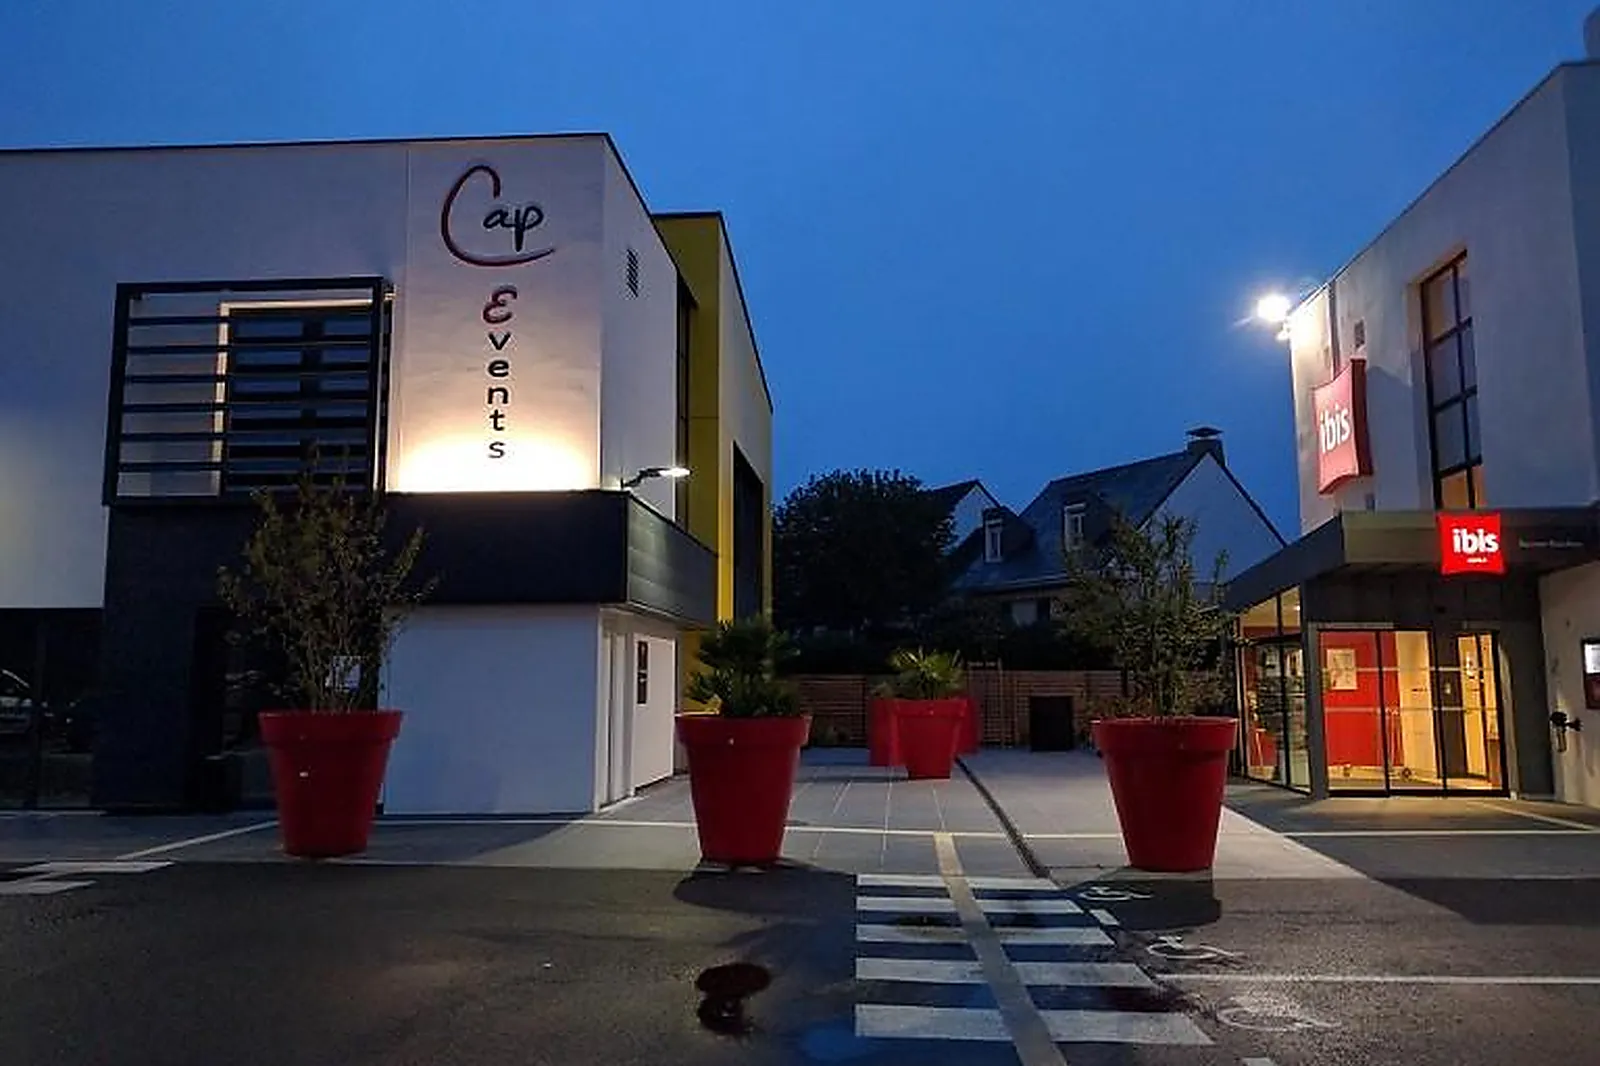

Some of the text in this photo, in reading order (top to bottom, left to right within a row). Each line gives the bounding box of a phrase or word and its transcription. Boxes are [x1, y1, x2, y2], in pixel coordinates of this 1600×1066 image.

[441, 164, 555, 266] Cap
[482, 286, 518, 459] Events
[1319, 403, 1350, 453] ibis
[1452, 527, 1499, 553] ibis
